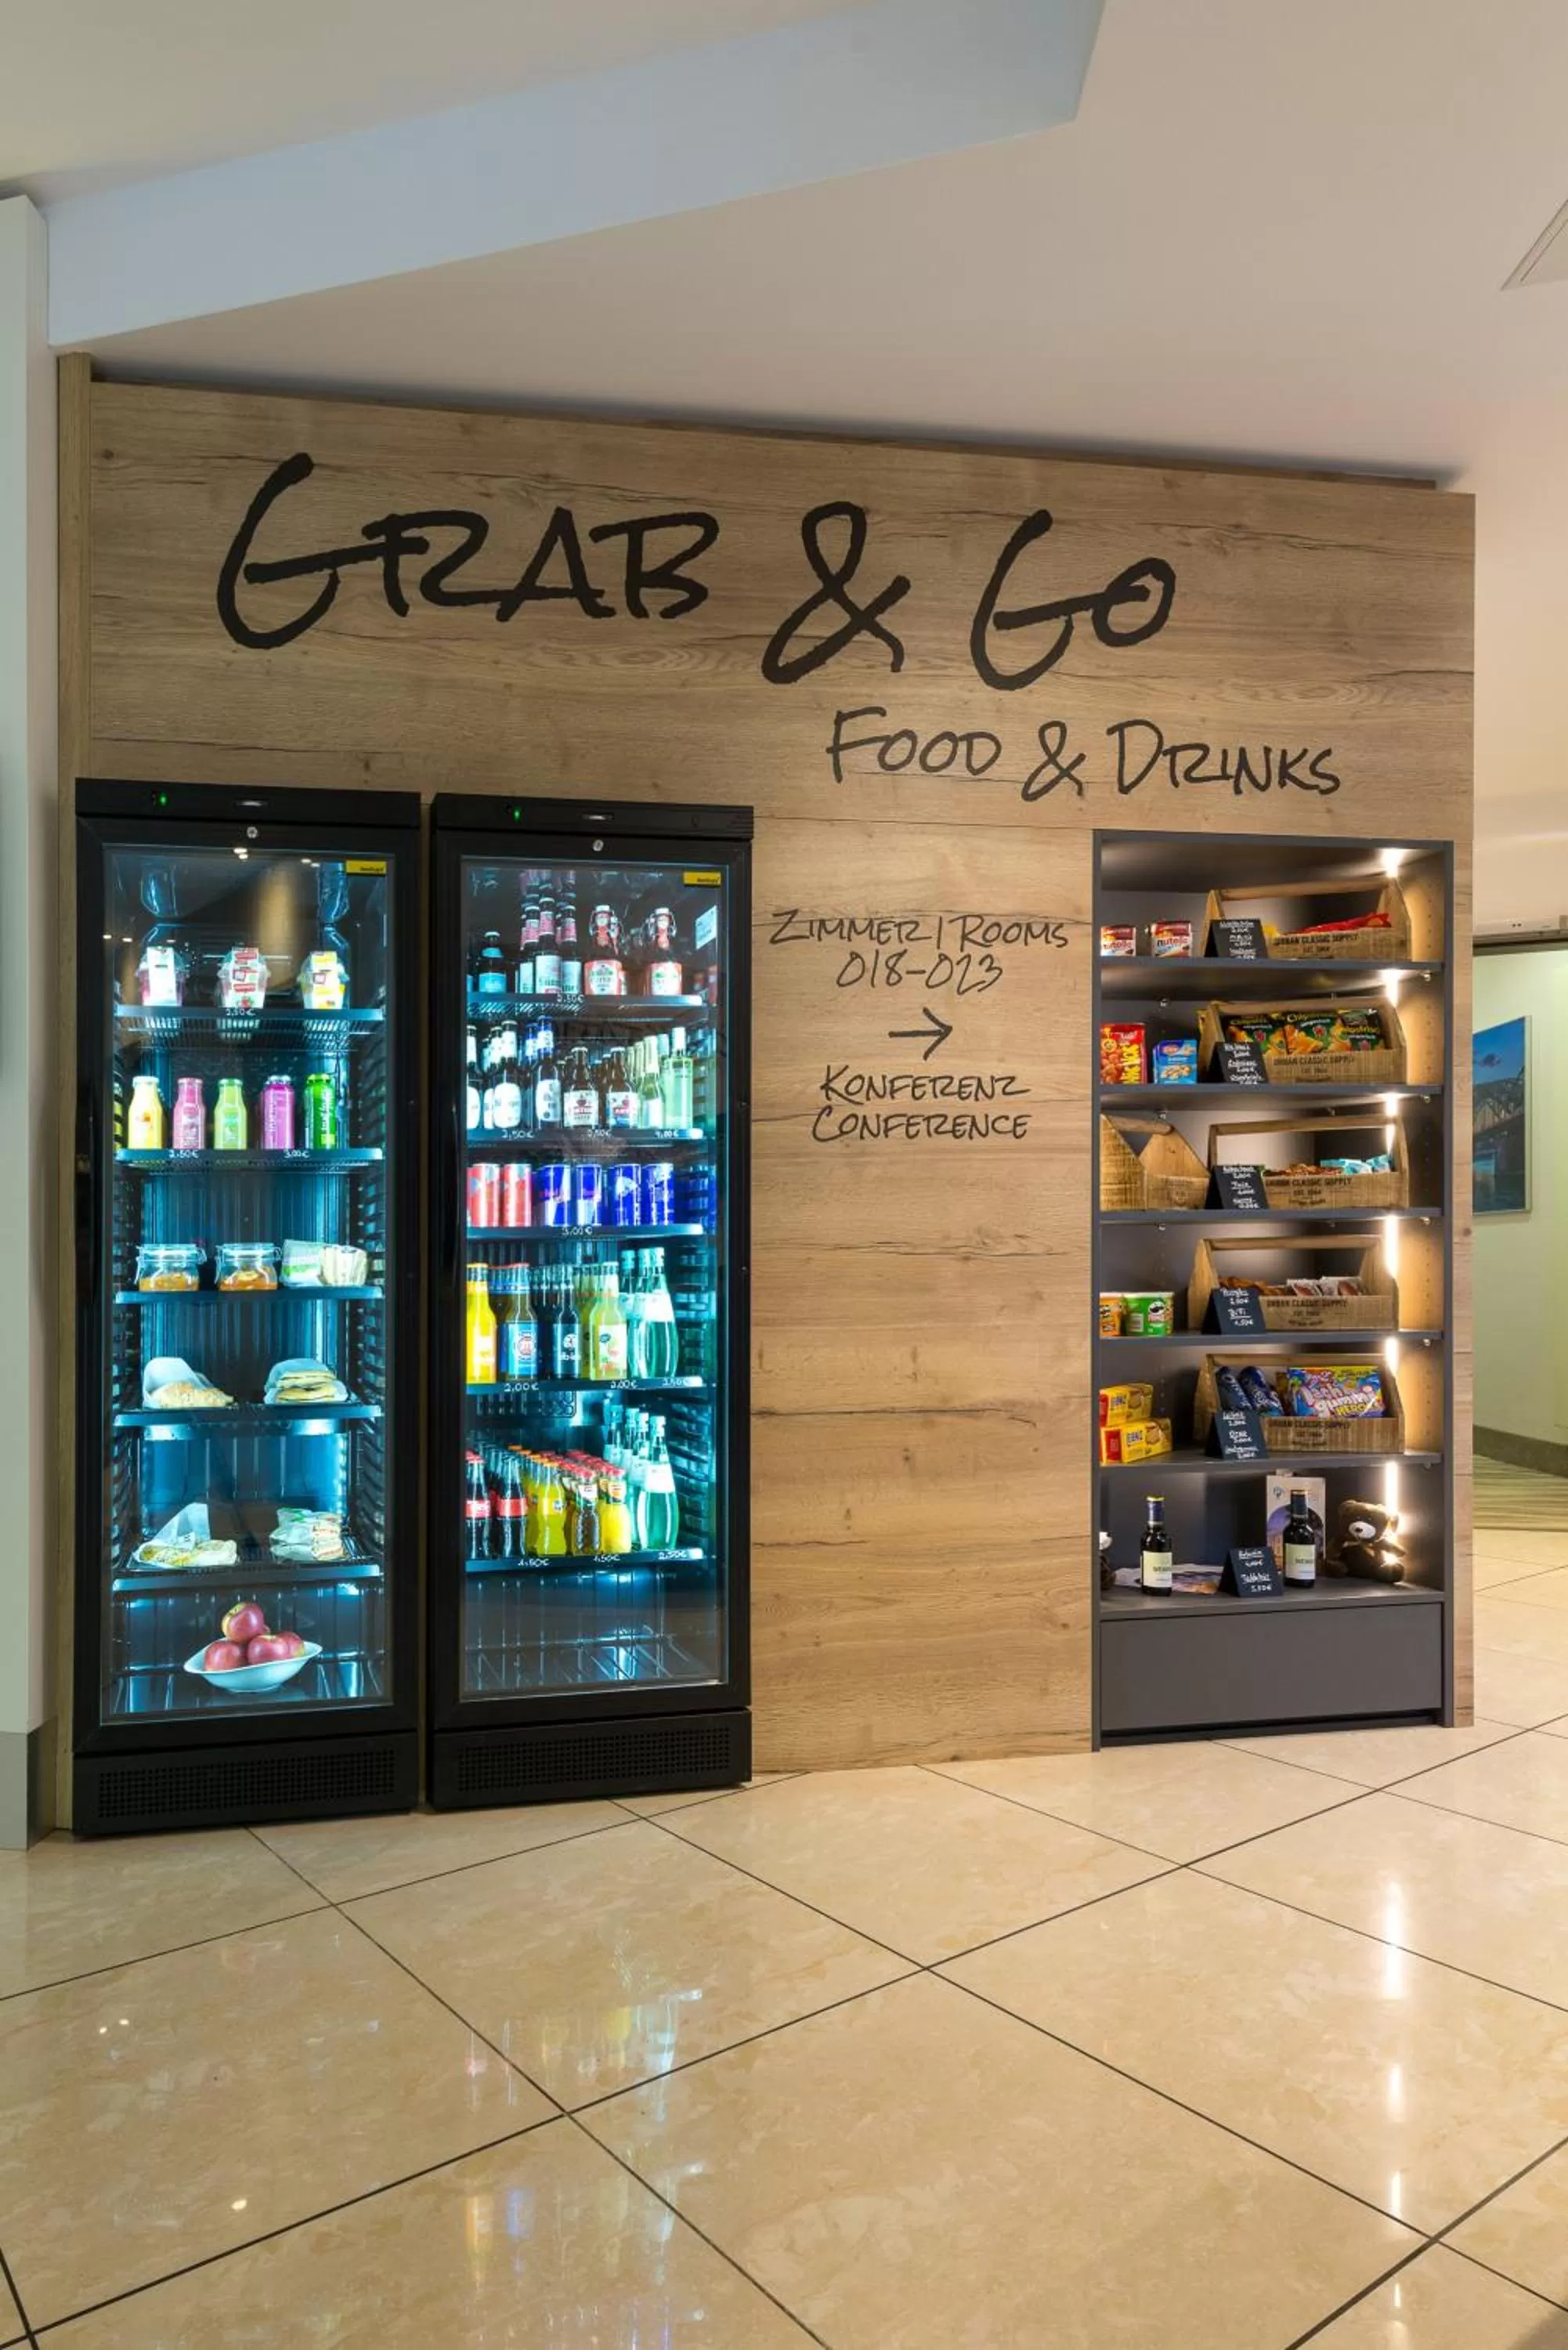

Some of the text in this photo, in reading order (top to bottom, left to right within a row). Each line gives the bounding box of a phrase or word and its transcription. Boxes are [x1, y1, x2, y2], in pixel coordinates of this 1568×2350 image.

[761, 501, 911, 685] &
[1021, 720, 1087, 803] &
[836, 949, 1003, 996] 018-023
